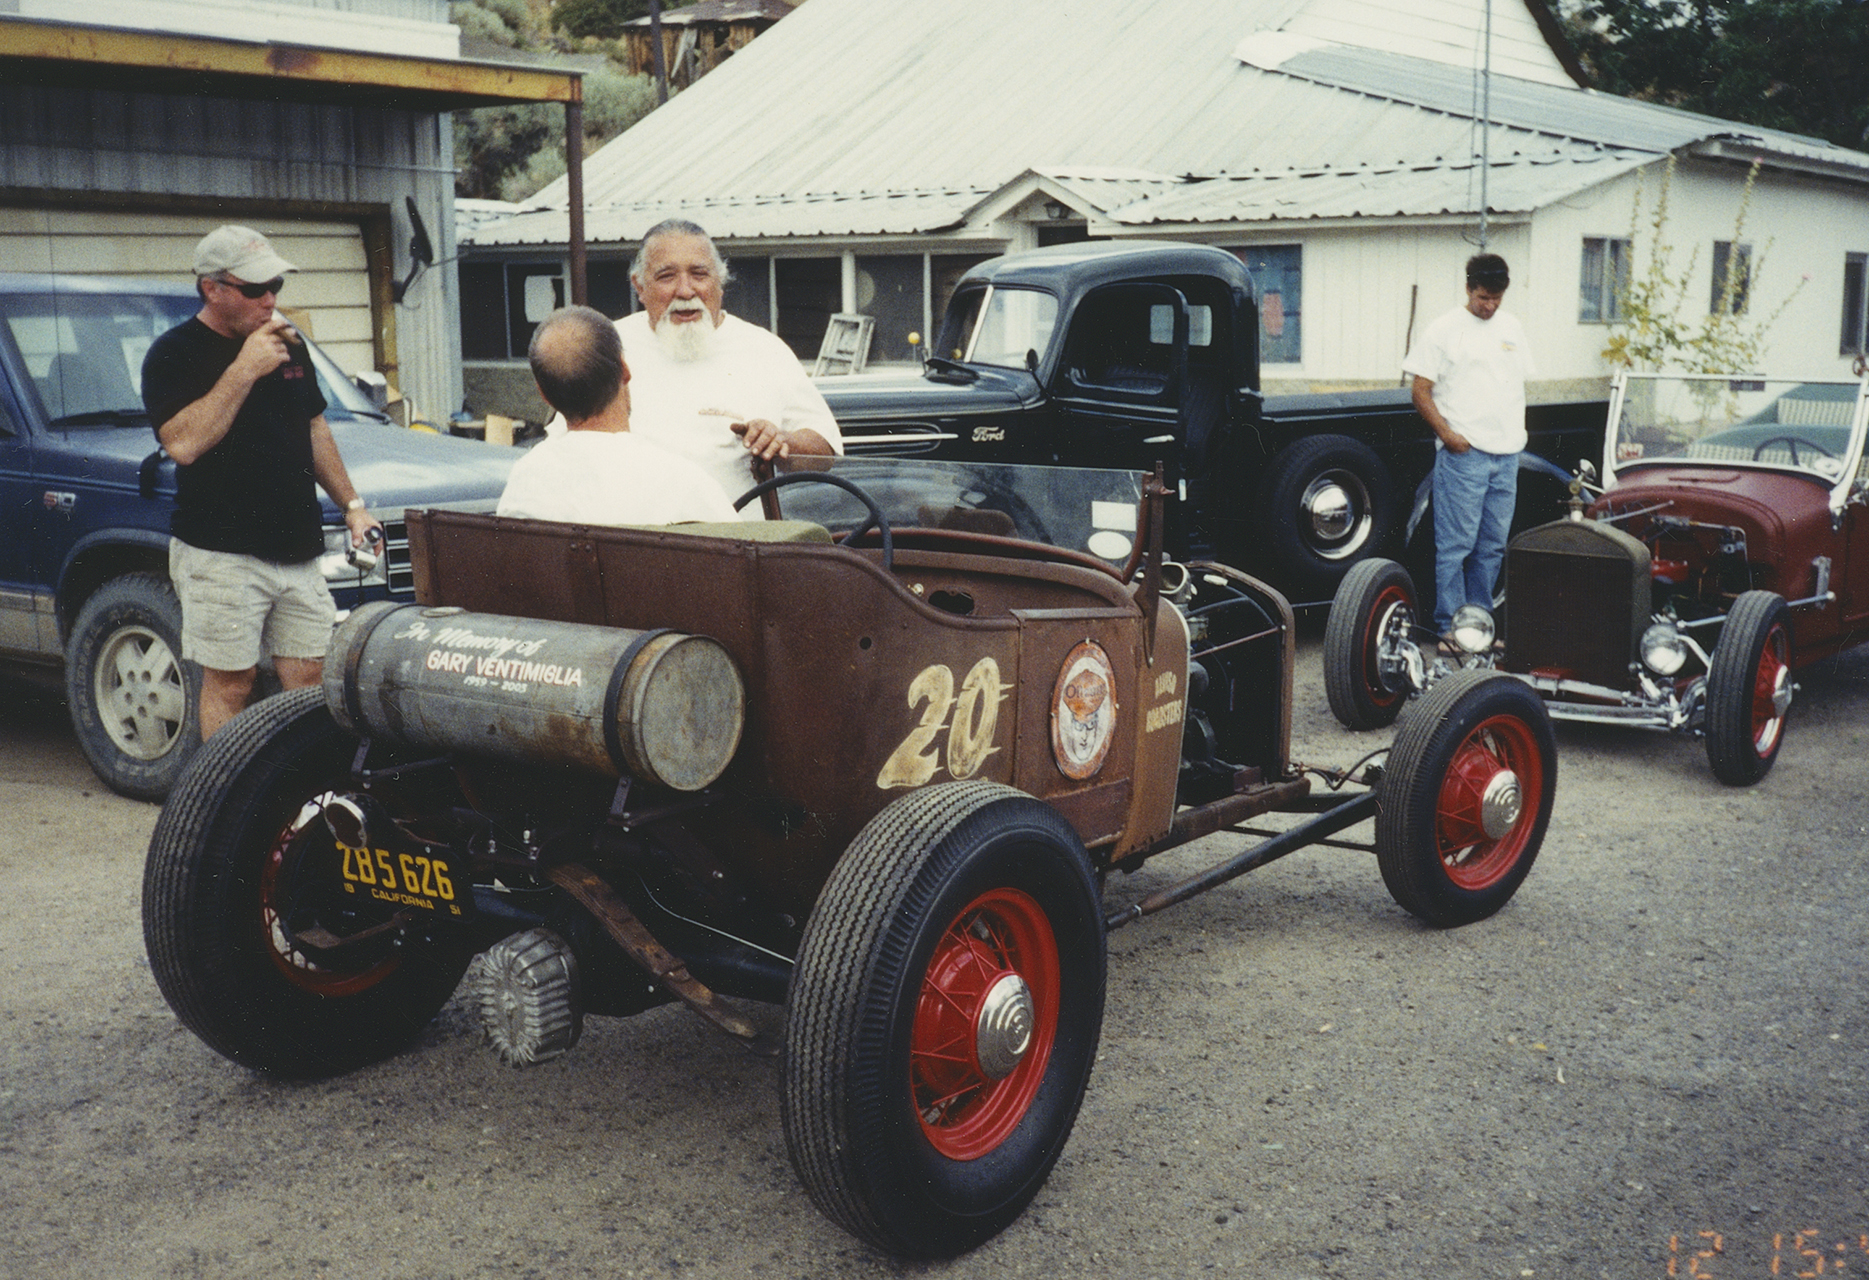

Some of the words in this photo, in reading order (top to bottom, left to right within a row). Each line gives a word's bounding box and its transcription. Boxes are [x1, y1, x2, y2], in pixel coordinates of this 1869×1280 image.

[971, 426, 1005, 442] Ford
[394, 622, 430, 641] In
[432, 627, 520, 658] Memory
[516, 638, 547, 657] of
[427, 650, 474, 673] GARY
[476, 656, 582, 687] VENTIMIGLIA
[876, 657, 1014, 789] 20
[371, 888, 434, 910] CALIFORNIA
